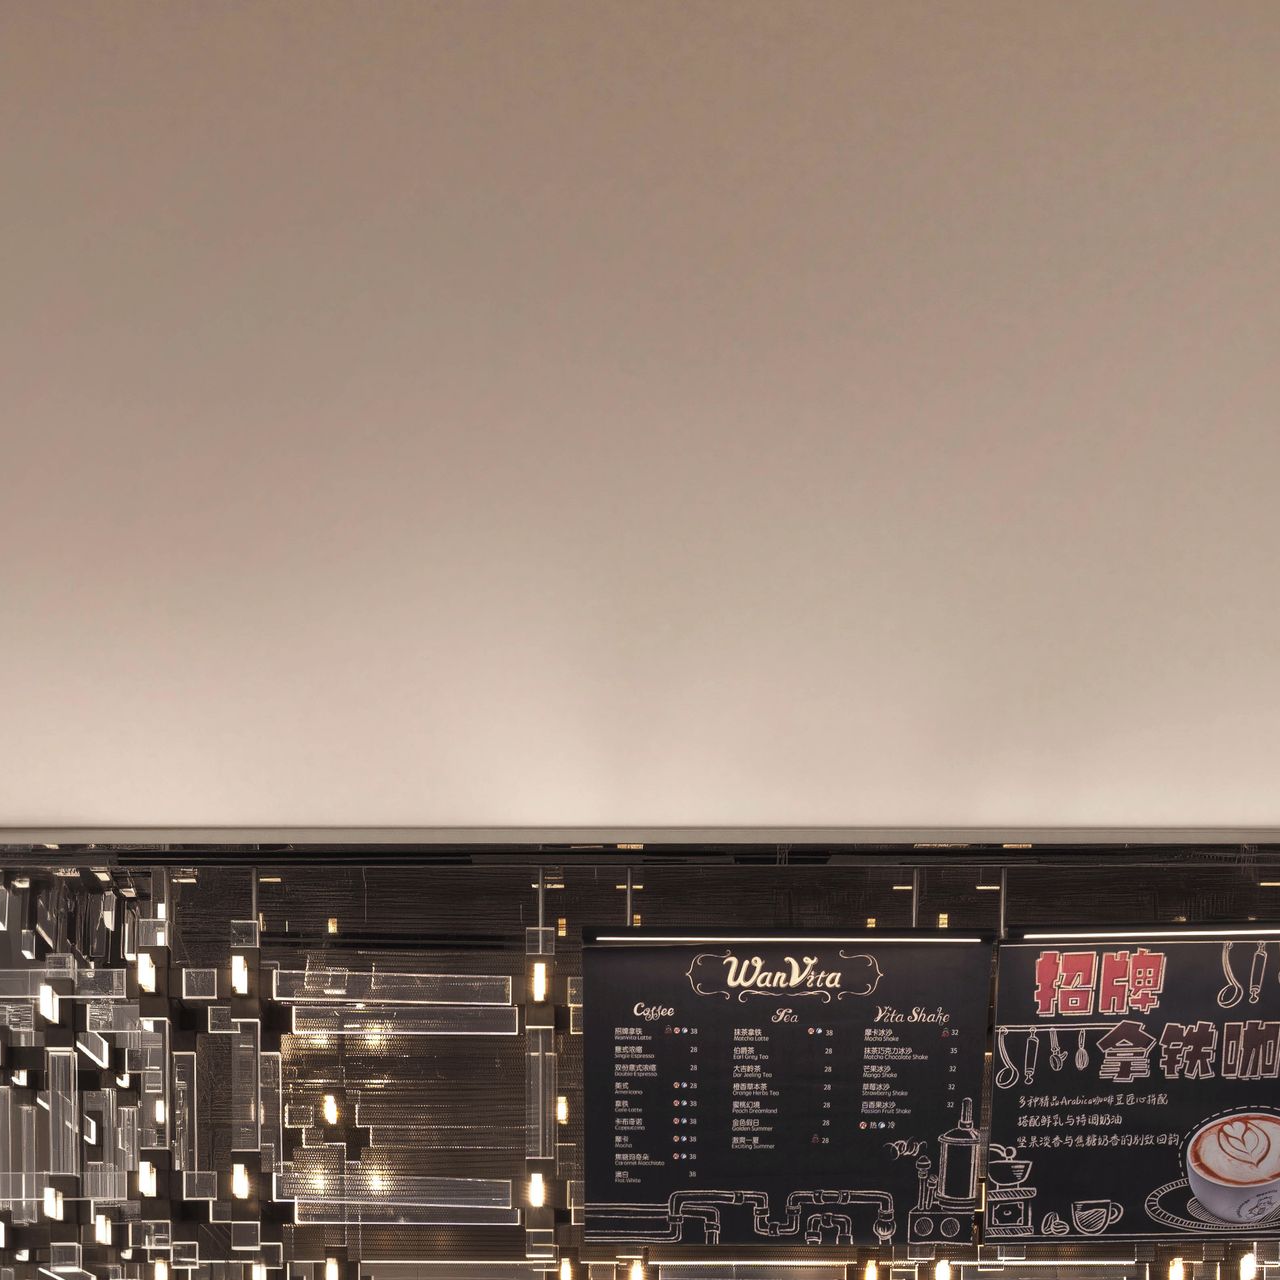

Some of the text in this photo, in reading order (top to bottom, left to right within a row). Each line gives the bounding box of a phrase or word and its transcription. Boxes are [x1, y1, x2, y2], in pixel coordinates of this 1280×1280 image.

[723, 956, 842, 988] WanVita
[1035, 947, 1166, 1016] 招牌
[633, 1002, 674, 1021] Coffee
[771, 1008, 799, 1023] Tea
[874, 1006, 950, 1026] Vita Shake
